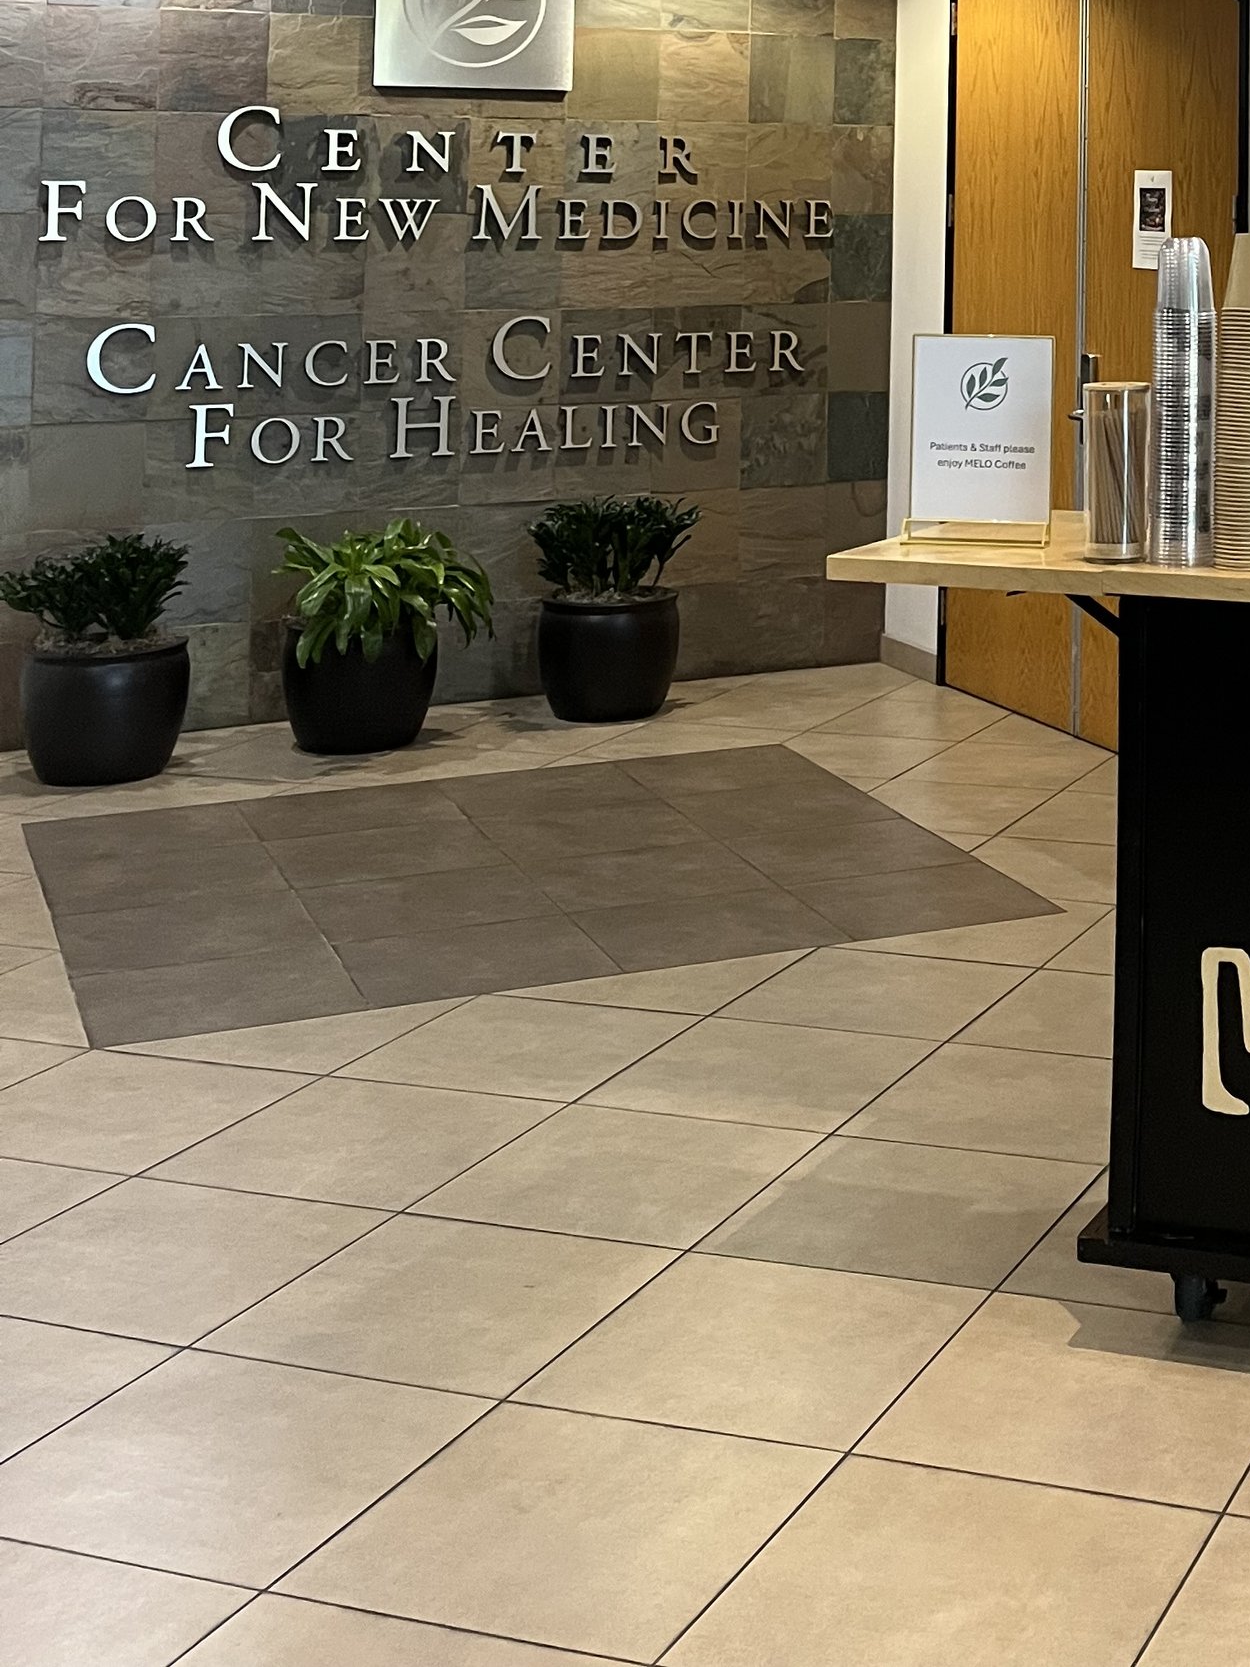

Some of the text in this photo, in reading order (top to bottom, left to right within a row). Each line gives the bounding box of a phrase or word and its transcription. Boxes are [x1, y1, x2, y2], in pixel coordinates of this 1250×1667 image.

[217, 105, 698, 175] CENTER
[38, 180, 834, 243] FOR NEW MEDICINE
[86, 315, 805, 394] CANCER CENTER
[185, 396, 720, 468] FOR HEALING
[930, 441, 1035, 454] Patients & Staff please
[937, 458, 1026, 470] enjoy MELO Coffee
